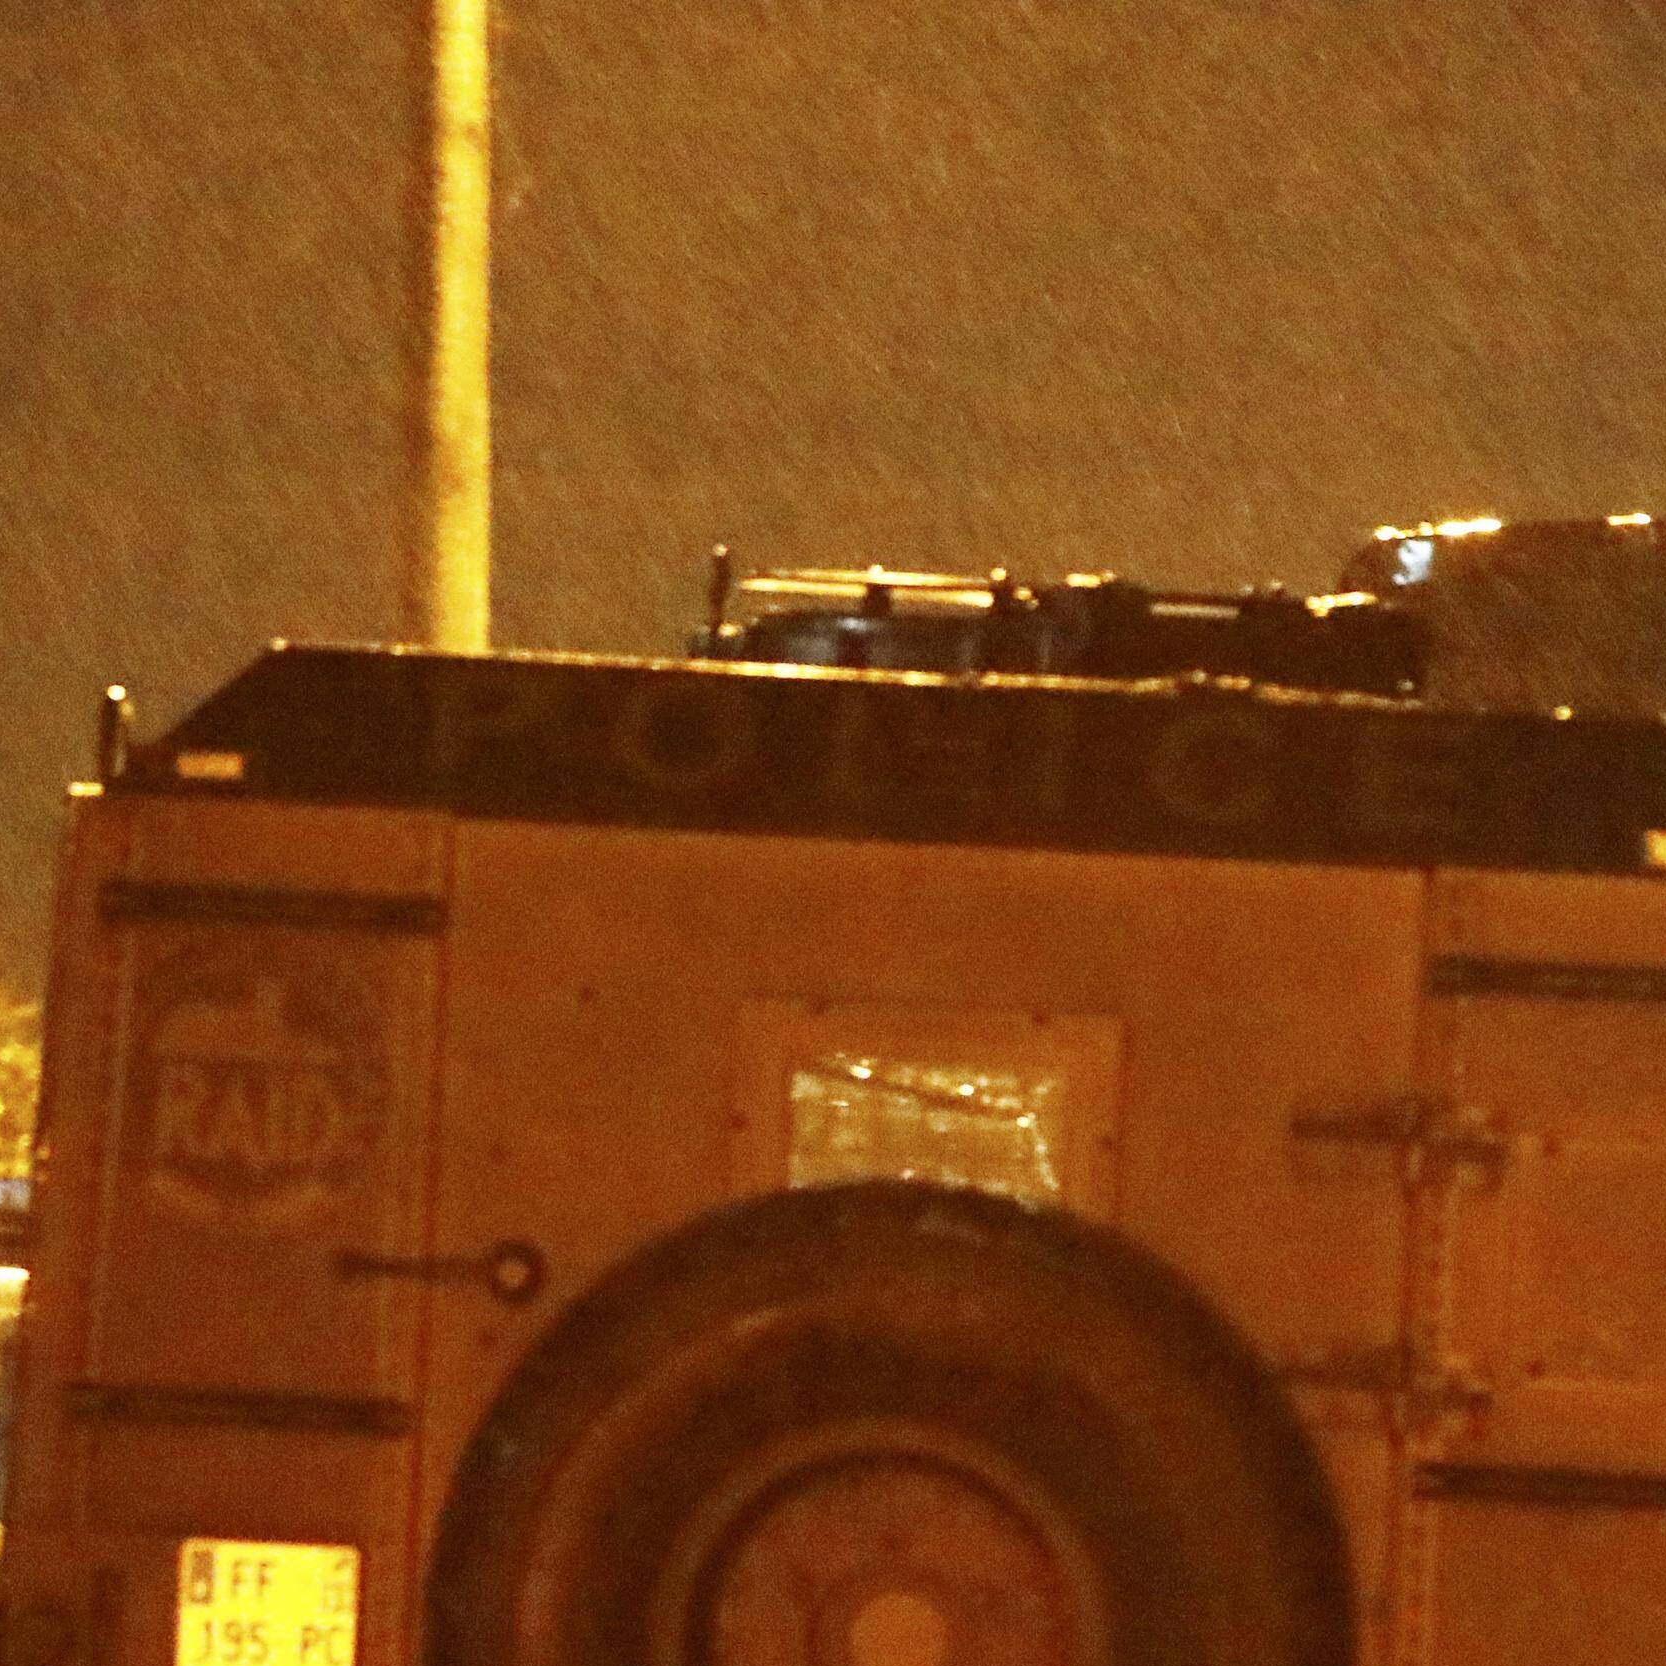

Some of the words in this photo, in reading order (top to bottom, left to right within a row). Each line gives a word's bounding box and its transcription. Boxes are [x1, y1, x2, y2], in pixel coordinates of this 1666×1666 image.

[428, 680, 1469, 830] POLICE
[155, 1060, 341, 1157] RAID
[231, 1557, 275, 1598] FF
[197, 1619, 268, 1665] 195
